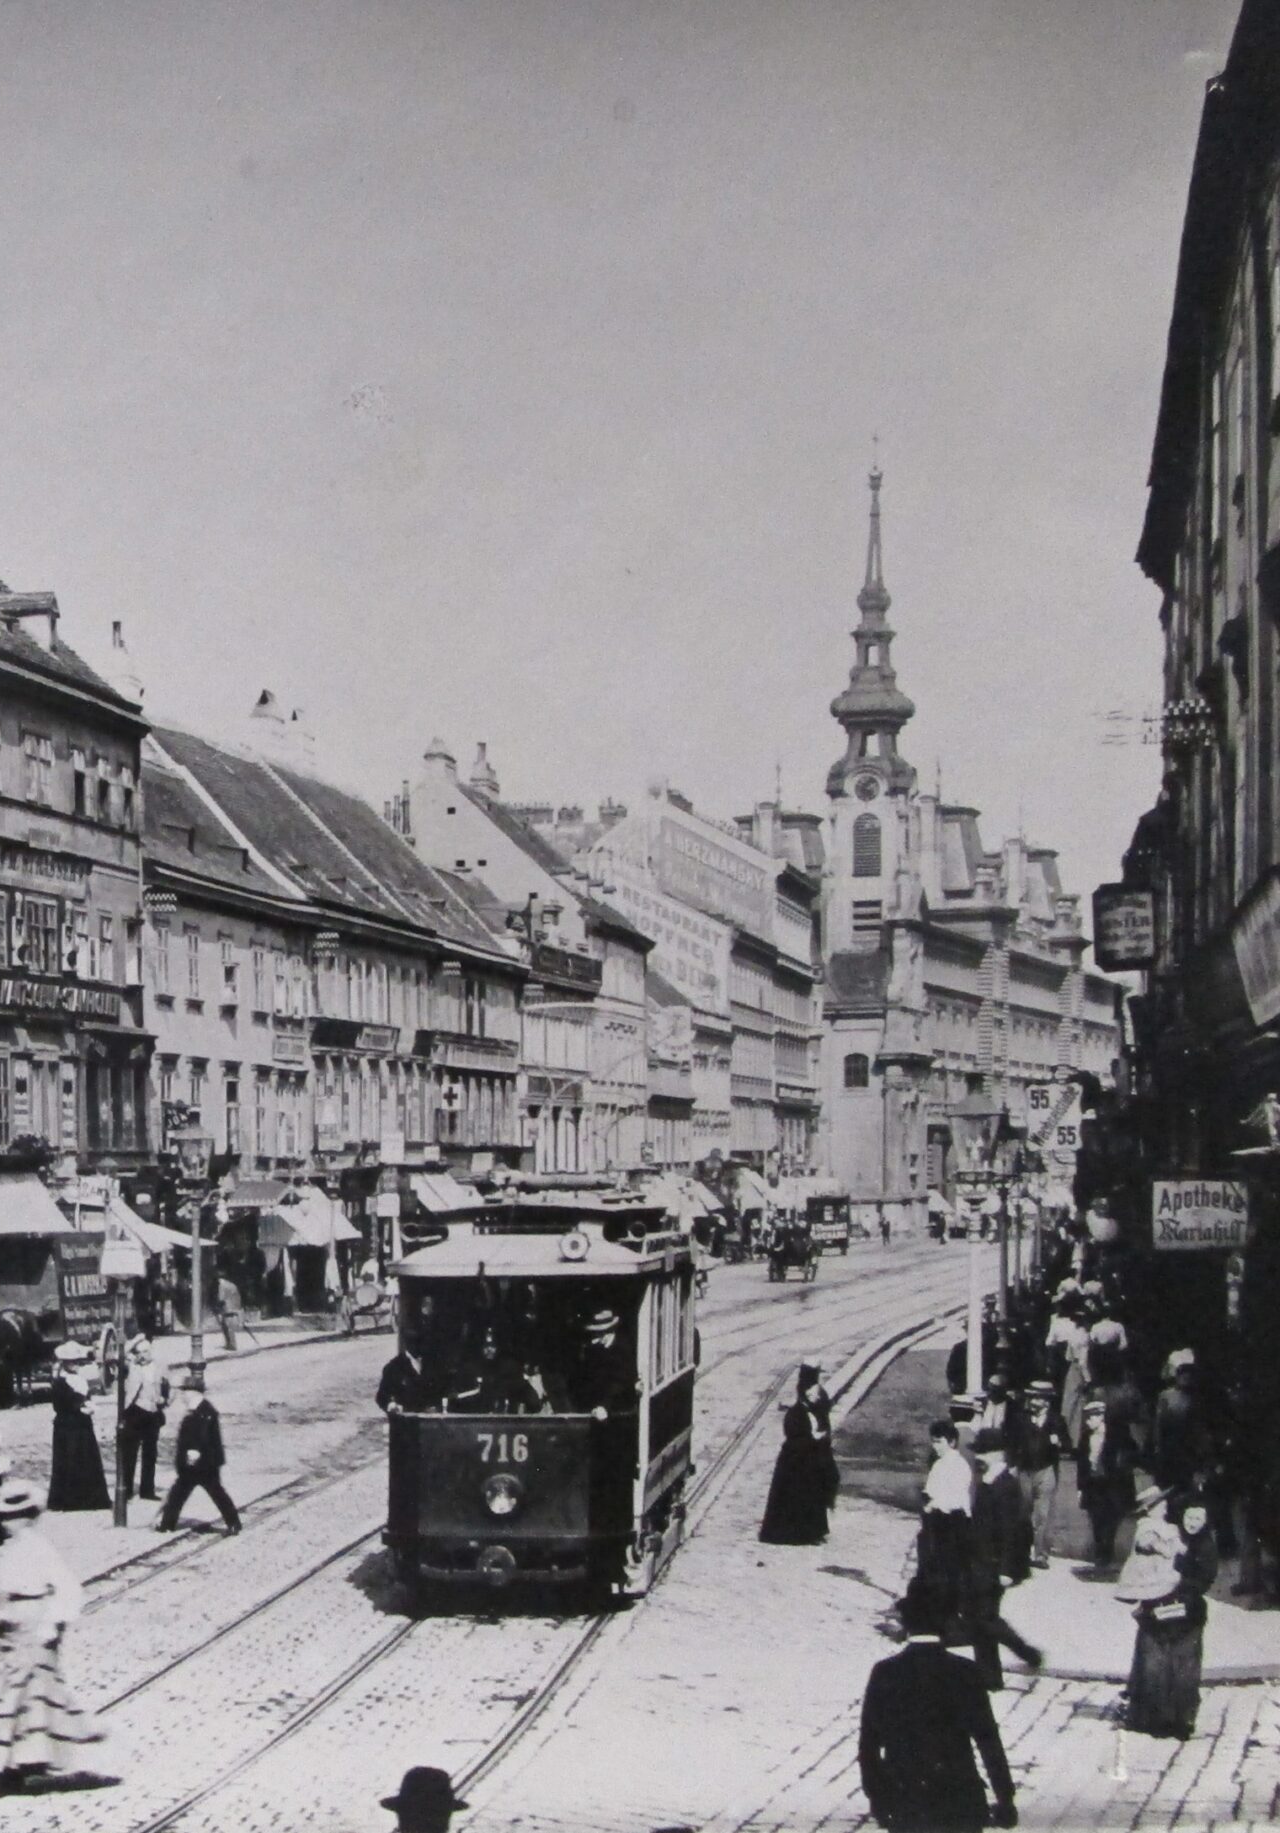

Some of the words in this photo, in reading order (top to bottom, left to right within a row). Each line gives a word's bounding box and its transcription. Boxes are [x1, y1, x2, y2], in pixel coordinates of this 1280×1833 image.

[1030, 1089, 1050, 1110] 55
[1056, 1126, 1077, 1146] 55
[1157, 1182, 1246, 1217] Apotheke
[477, 1433, 529, 1463] 716
